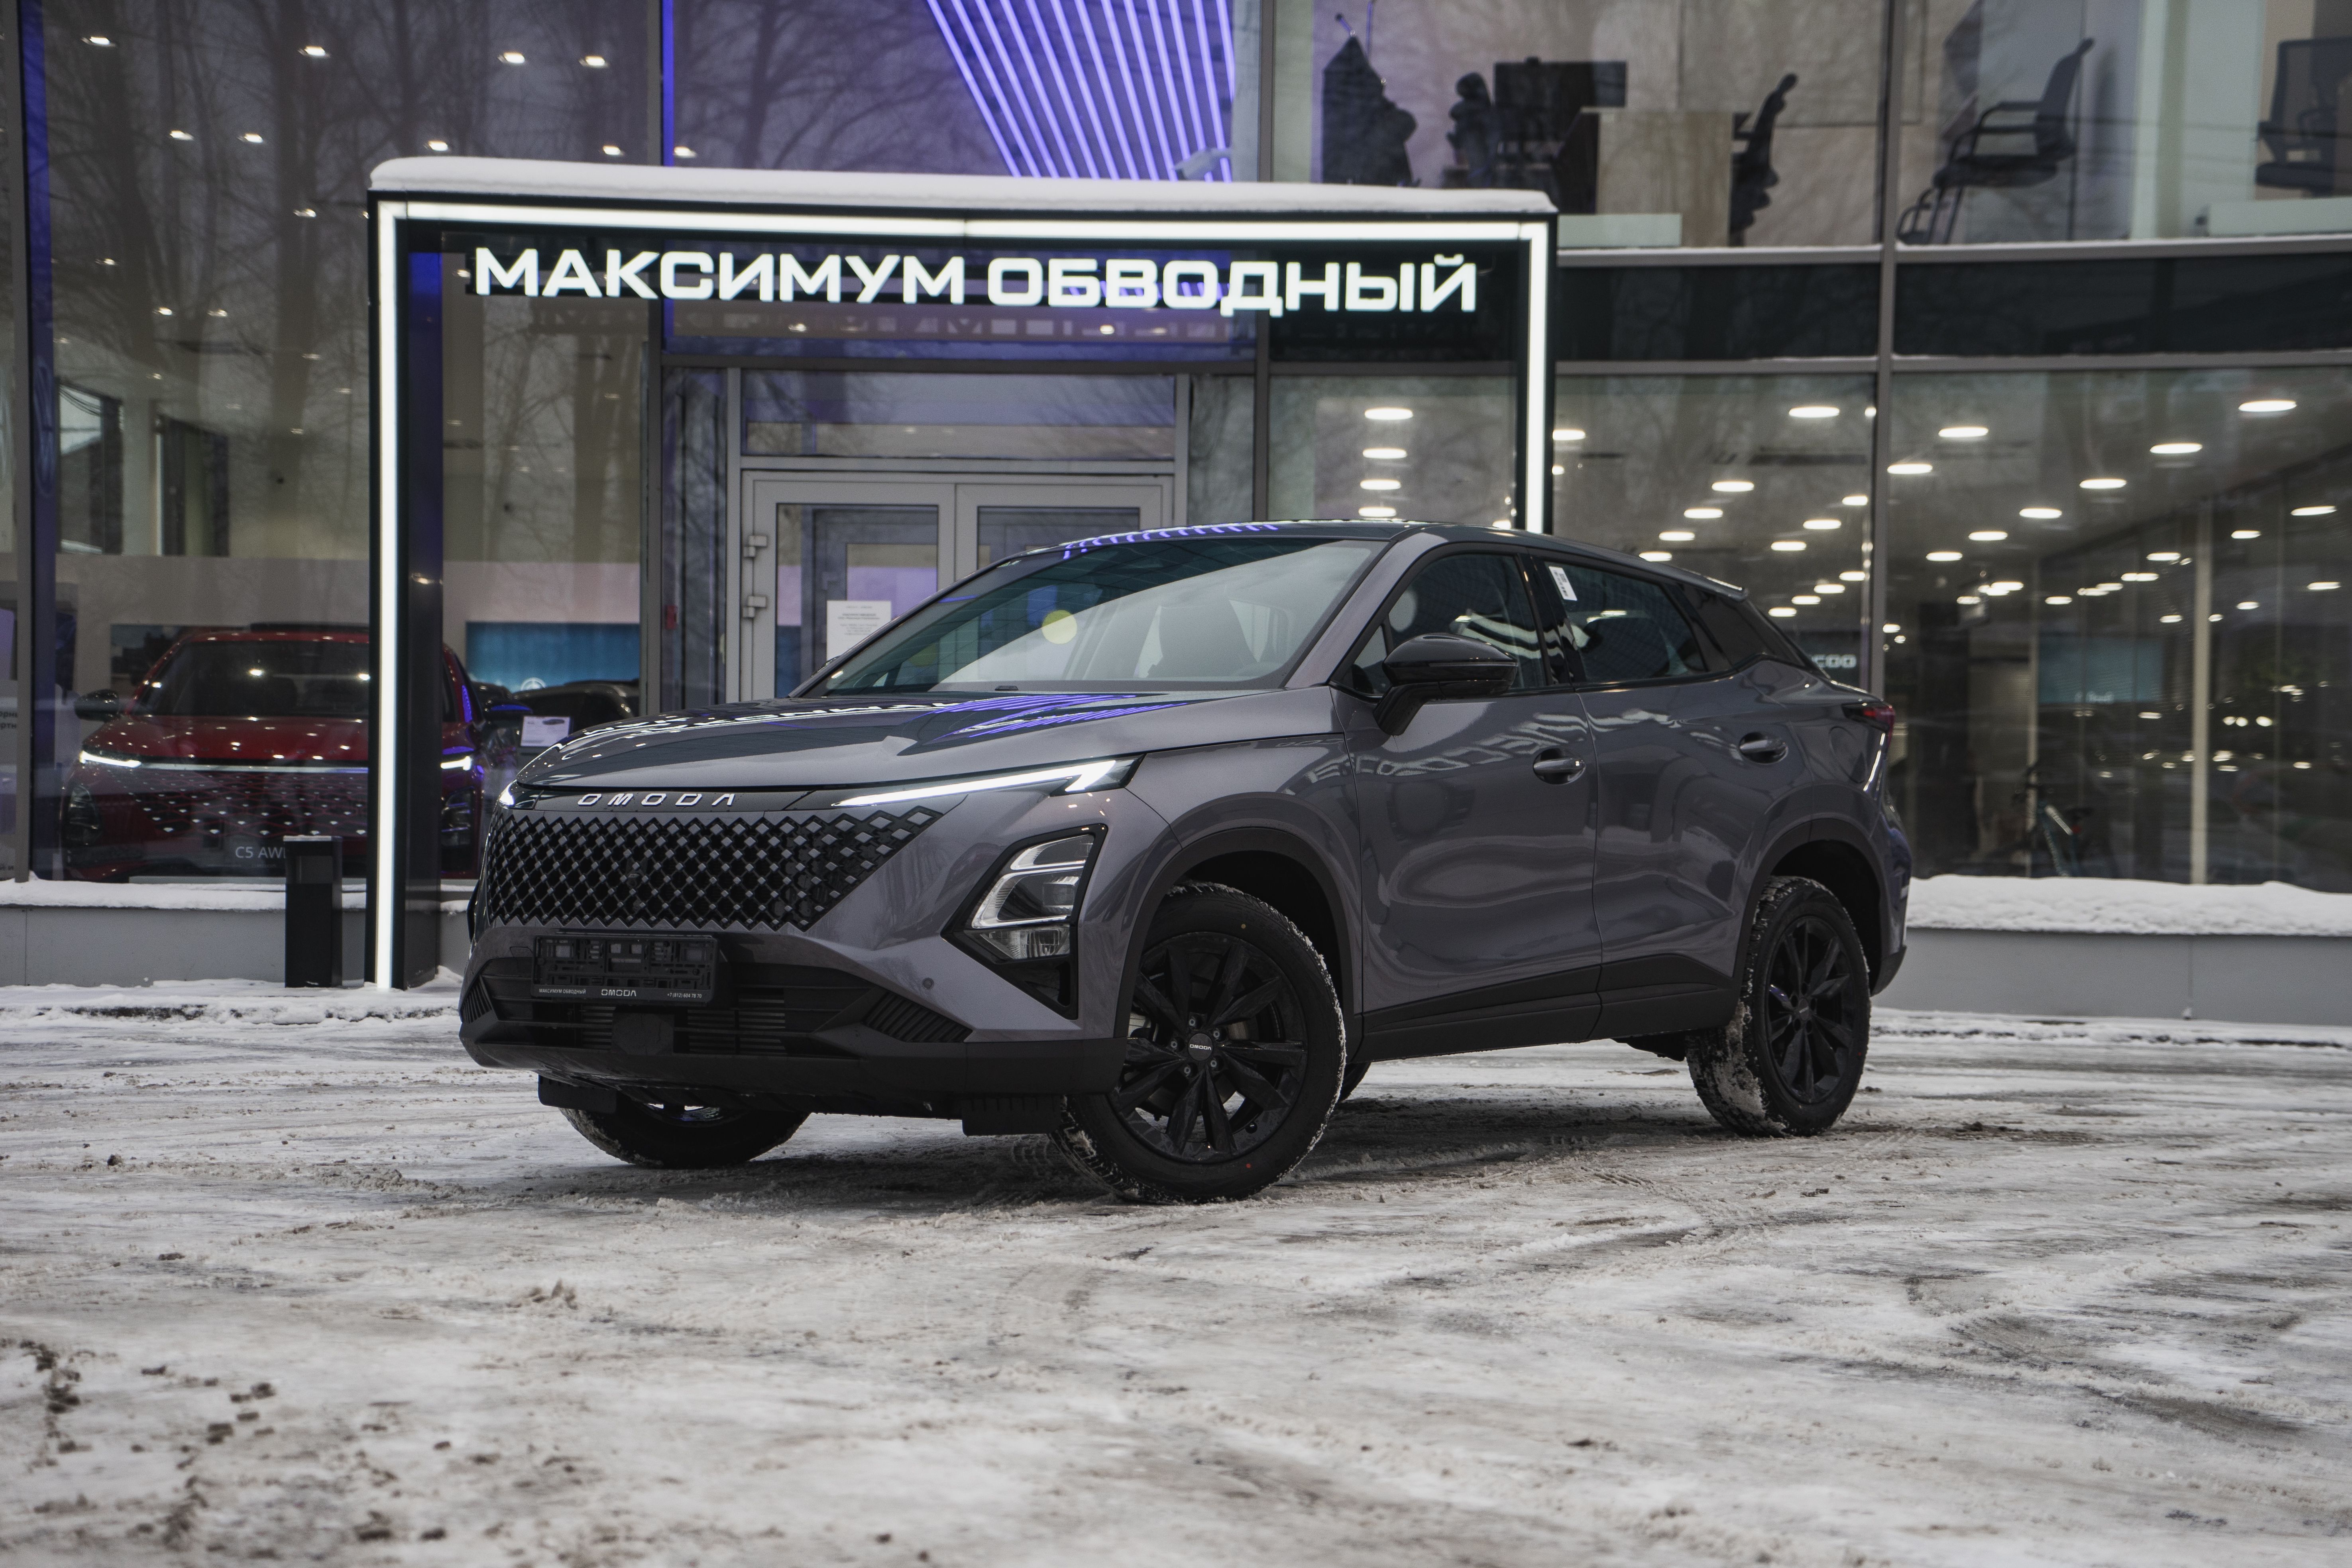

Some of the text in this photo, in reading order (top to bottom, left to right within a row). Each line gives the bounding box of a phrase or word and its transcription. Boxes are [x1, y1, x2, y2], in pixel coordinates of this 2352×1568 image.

[476, 248, 1476, 317] МАКСИМУМ ОБВОДНЫЙ
[578, 793, 735, 806] OMODA
[235, 846, 285, 859] C5 AW
